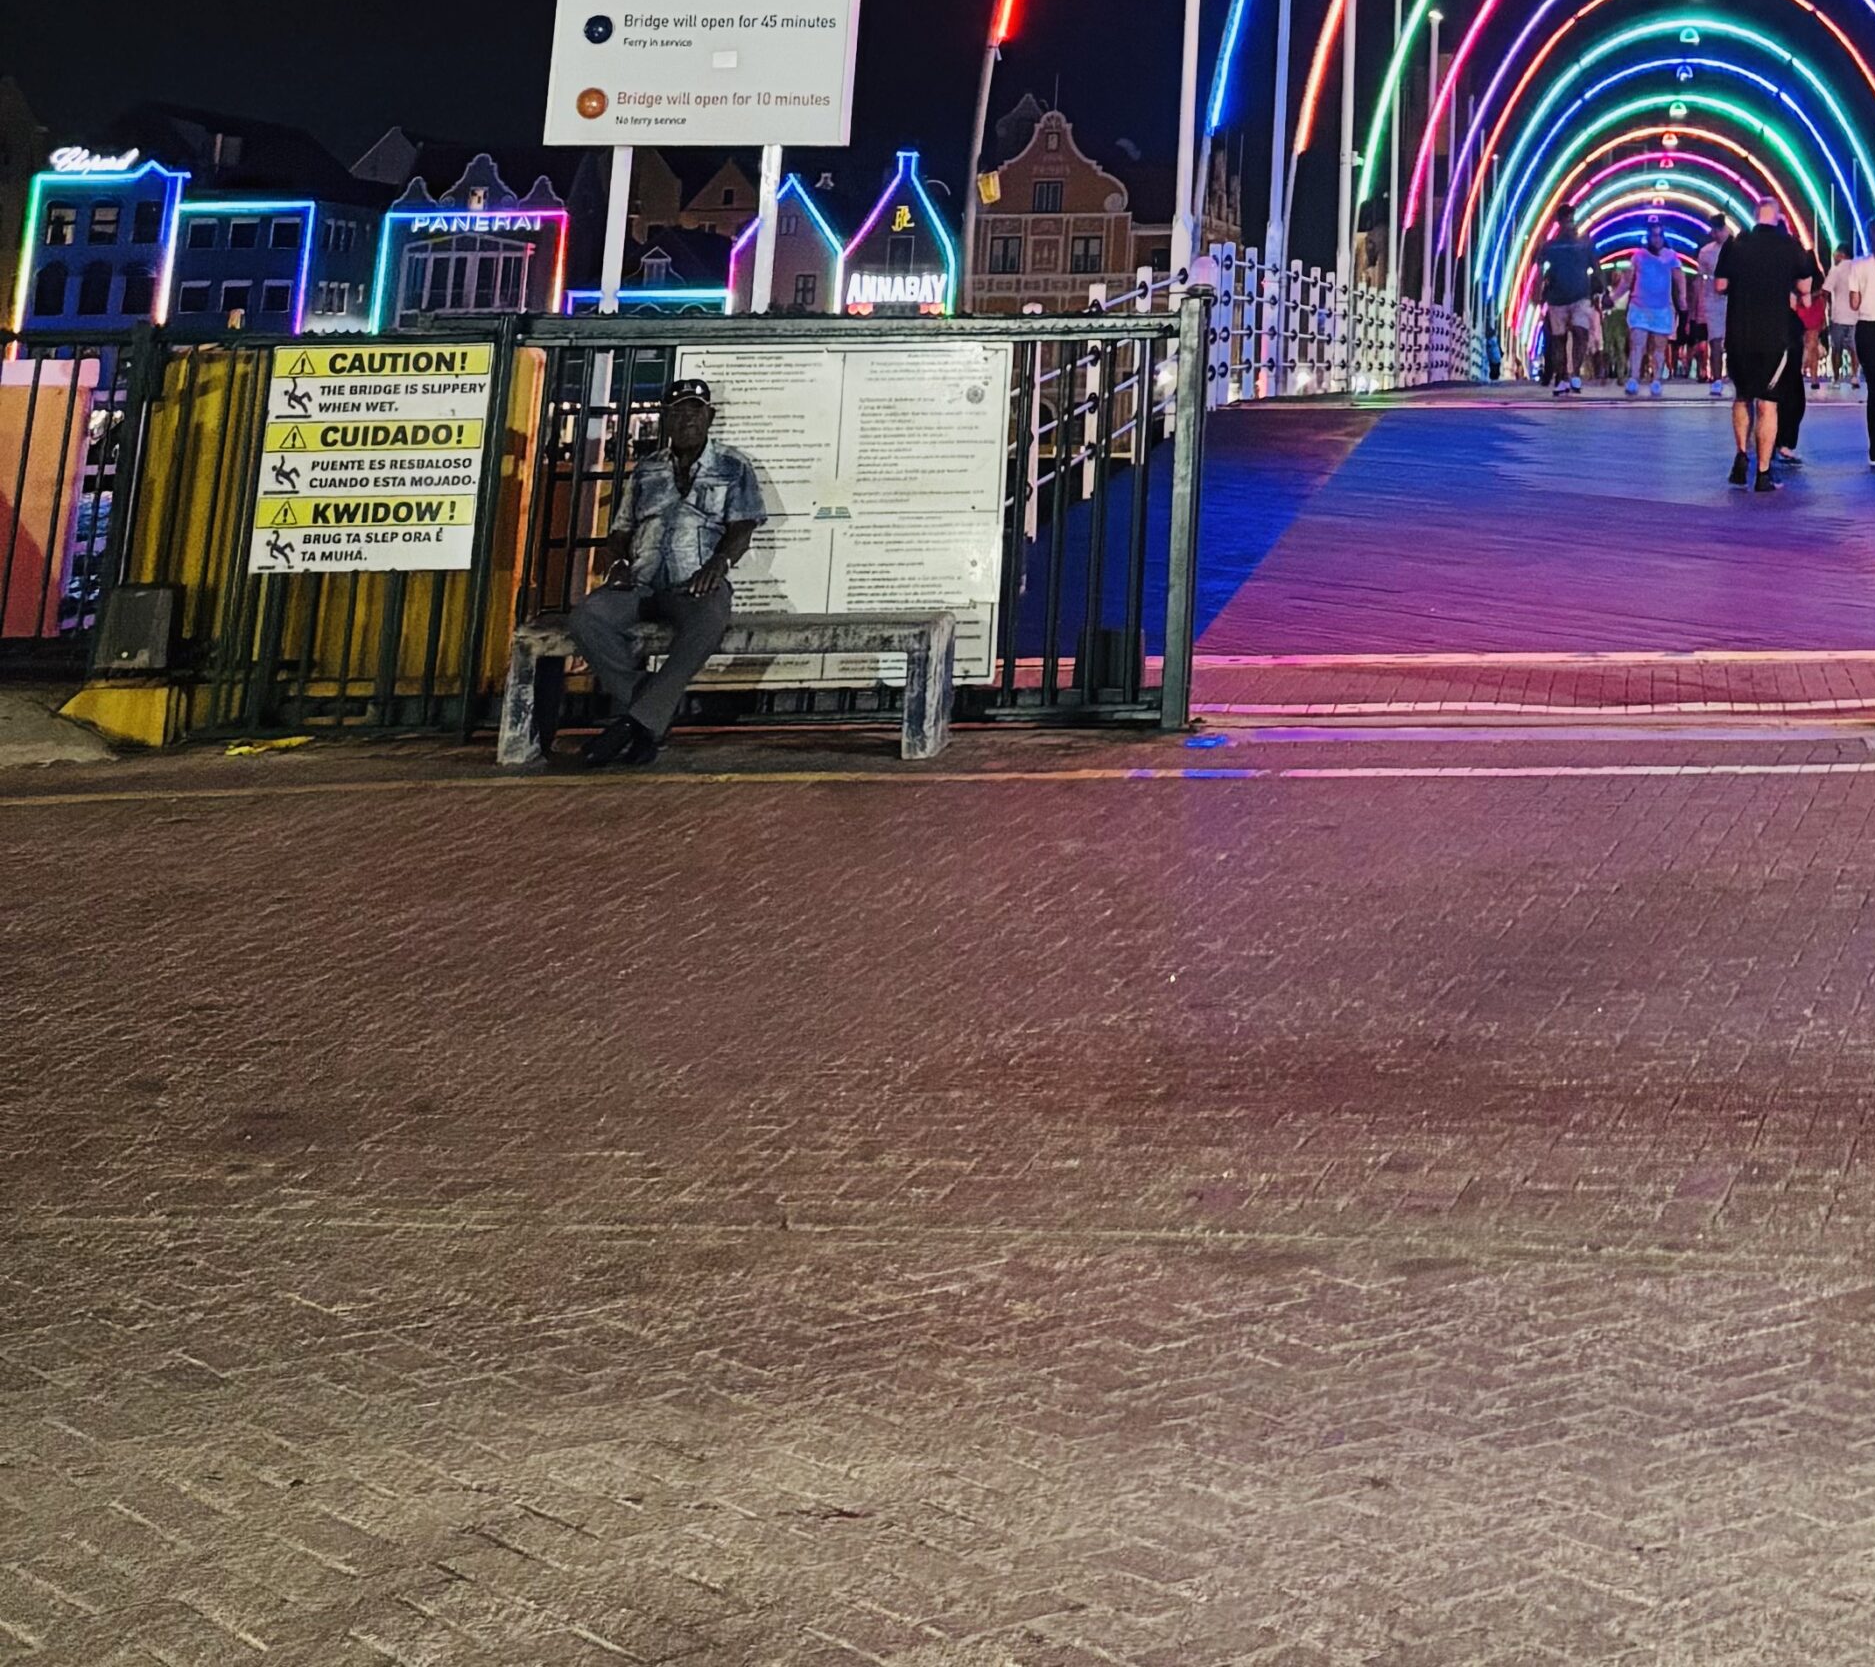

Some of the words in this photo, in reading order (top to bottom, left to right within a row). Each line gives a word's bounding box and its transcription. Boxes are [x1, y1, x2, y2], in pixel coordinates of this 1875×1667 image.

[624, 14, 669, 29] Bridge
[673, 15, 697, 27] will
[701, 18, 734, 30] open
[739, 15, 758, 28] for
[761, 15, 778, 28] 45
[781, 16, 836, 28] minutes
[623, 38, 647, 48] Ferry
[649, 38, 658, 46] in
[660, 38, 692, 47] service
[617, 92, 662, 108] Bridge
[667, 93, 690, 105] will
[694, 95, 728, 108] open
[732, 93, 751, 105] for
[756, 93, 771, 105] 10
[774, 93, 830, 106] minutes
[616, 116, 628, 125] No
[411, 215, 541, 233] PANERAI
[846, 273, 947, 304] ANNABAY
[328, 352, 468, 374] CAUTION!
[320, 385, 345, 395] THE
[349, 384, 401, 395] BRIDGE
[405, 384, 417, 394] IS
[421, 383, 486, 394] SLIPPERY
[318, 402, 361, 413] WHEN
[365, 401, 399, 412] WET.
[320, 425, 464, 447] CUIDADO!
[311, 460, 364, 471] PUENTE
[370, 459, 386, 470] ES
[390, 458, 472, 470] RESBALOSO
[309, 477, 370, 488] CUANDO
[374, 477, 406, 487] ESTA
[410, 475, 476, 487] MOJADO.
[302, 533, 342, 544] BRUG
[345, 533, 361, 544] TA
[364, 532, 398, 543] SLEP
[402, 531, 431, 542] ORA
[301, 551, 317, 561] TA
